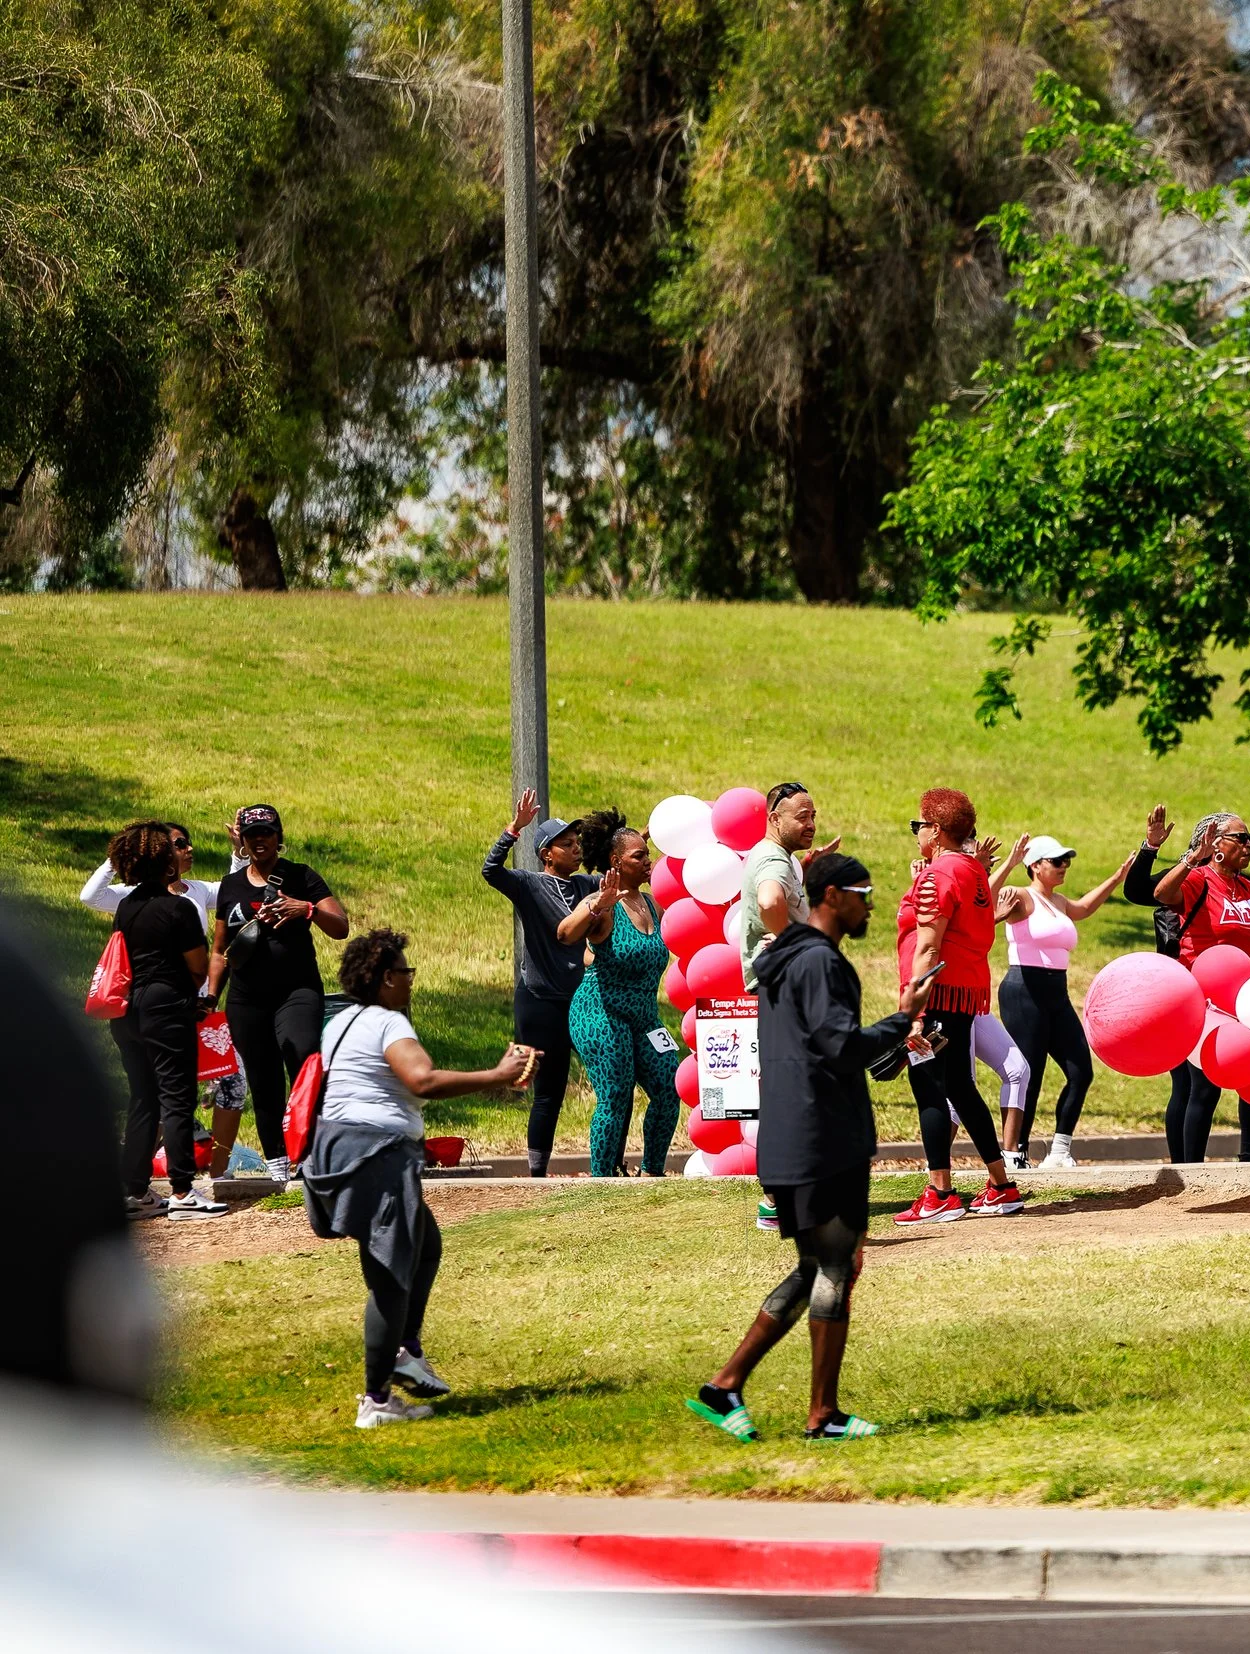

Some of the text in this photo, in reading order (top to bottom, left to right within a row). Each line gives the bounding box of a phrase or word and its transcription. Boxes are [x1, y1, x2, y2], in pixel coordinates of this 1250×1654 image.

[709, 997, 759, 1010] Tempe Alum
[698, 1009, 713, 1017] Delta
[714, 1009, 732, 1018] Sigma
[732, 1008, 749, 1016] Theta
[706, 1036, 730, 1052] Soul
[709, 1053, 739, 1069] Stroll
